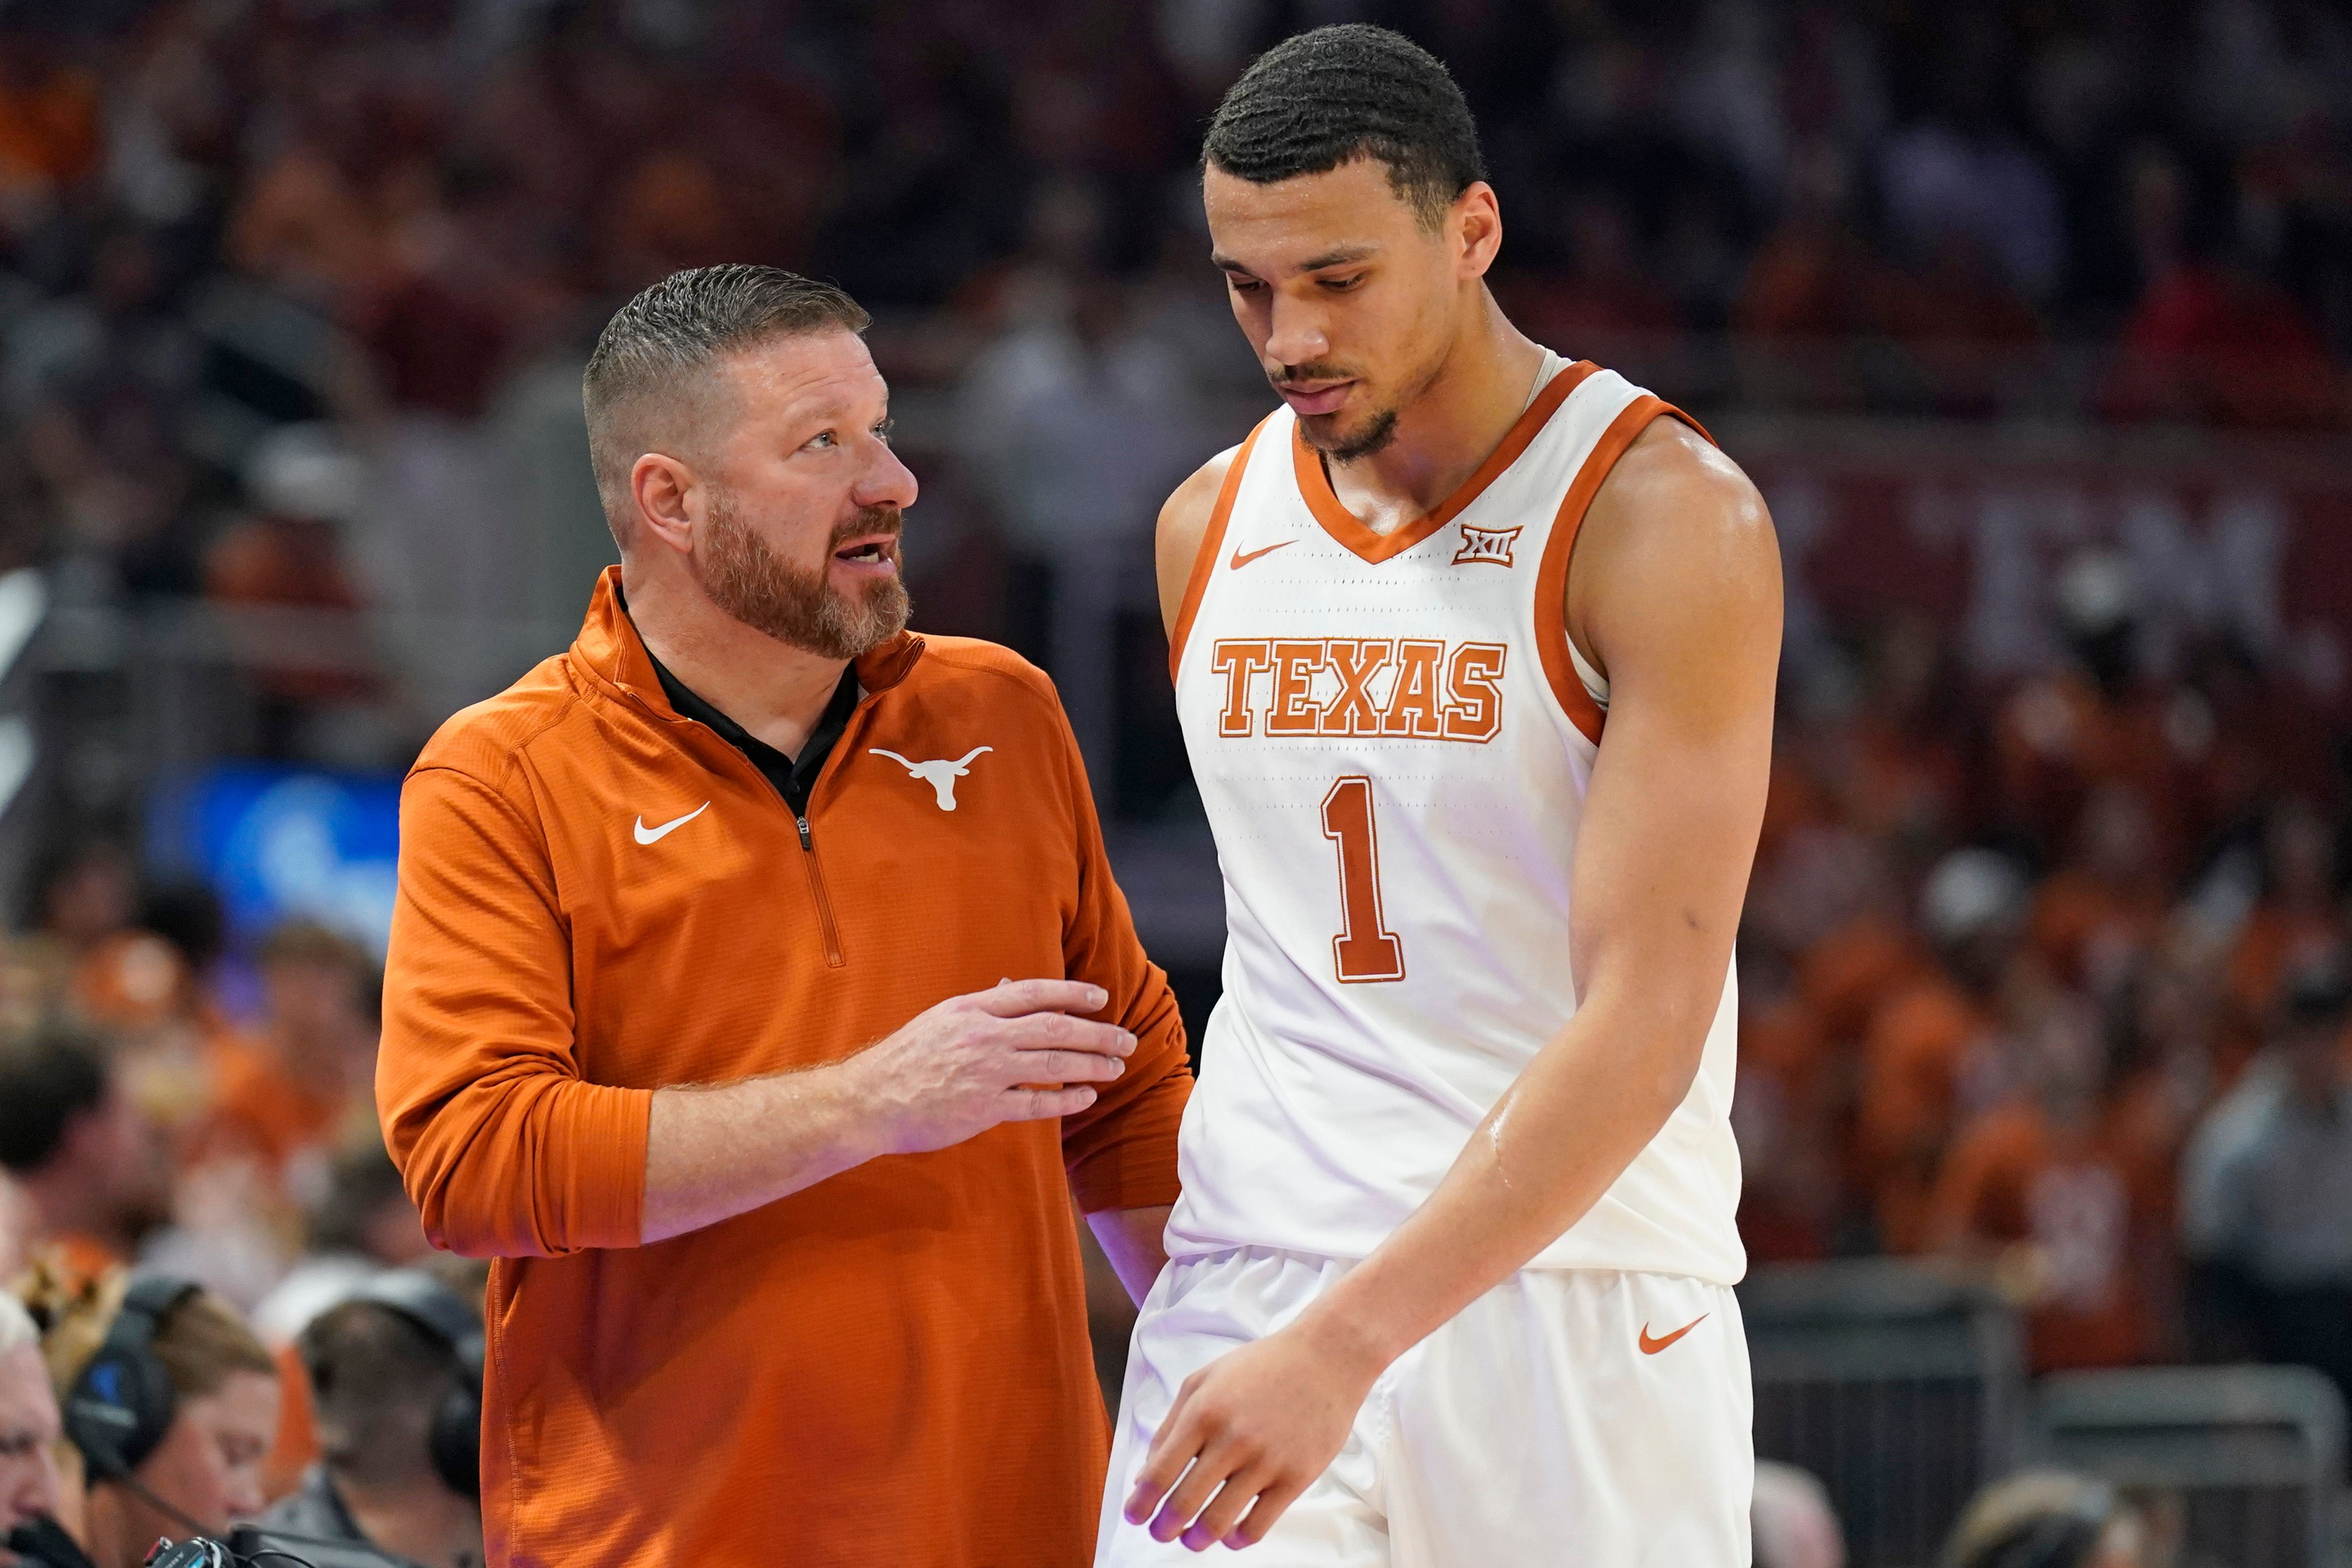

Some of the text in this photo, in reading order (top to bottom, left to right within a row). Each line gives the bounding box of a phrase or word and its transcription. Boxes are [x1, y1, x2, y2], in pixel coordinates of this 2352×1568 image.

[1452, 525, 1523, 568] XII
[1212, 637, 1508, 744] TEXAS
[1320, 776, 1406, 983] 1
